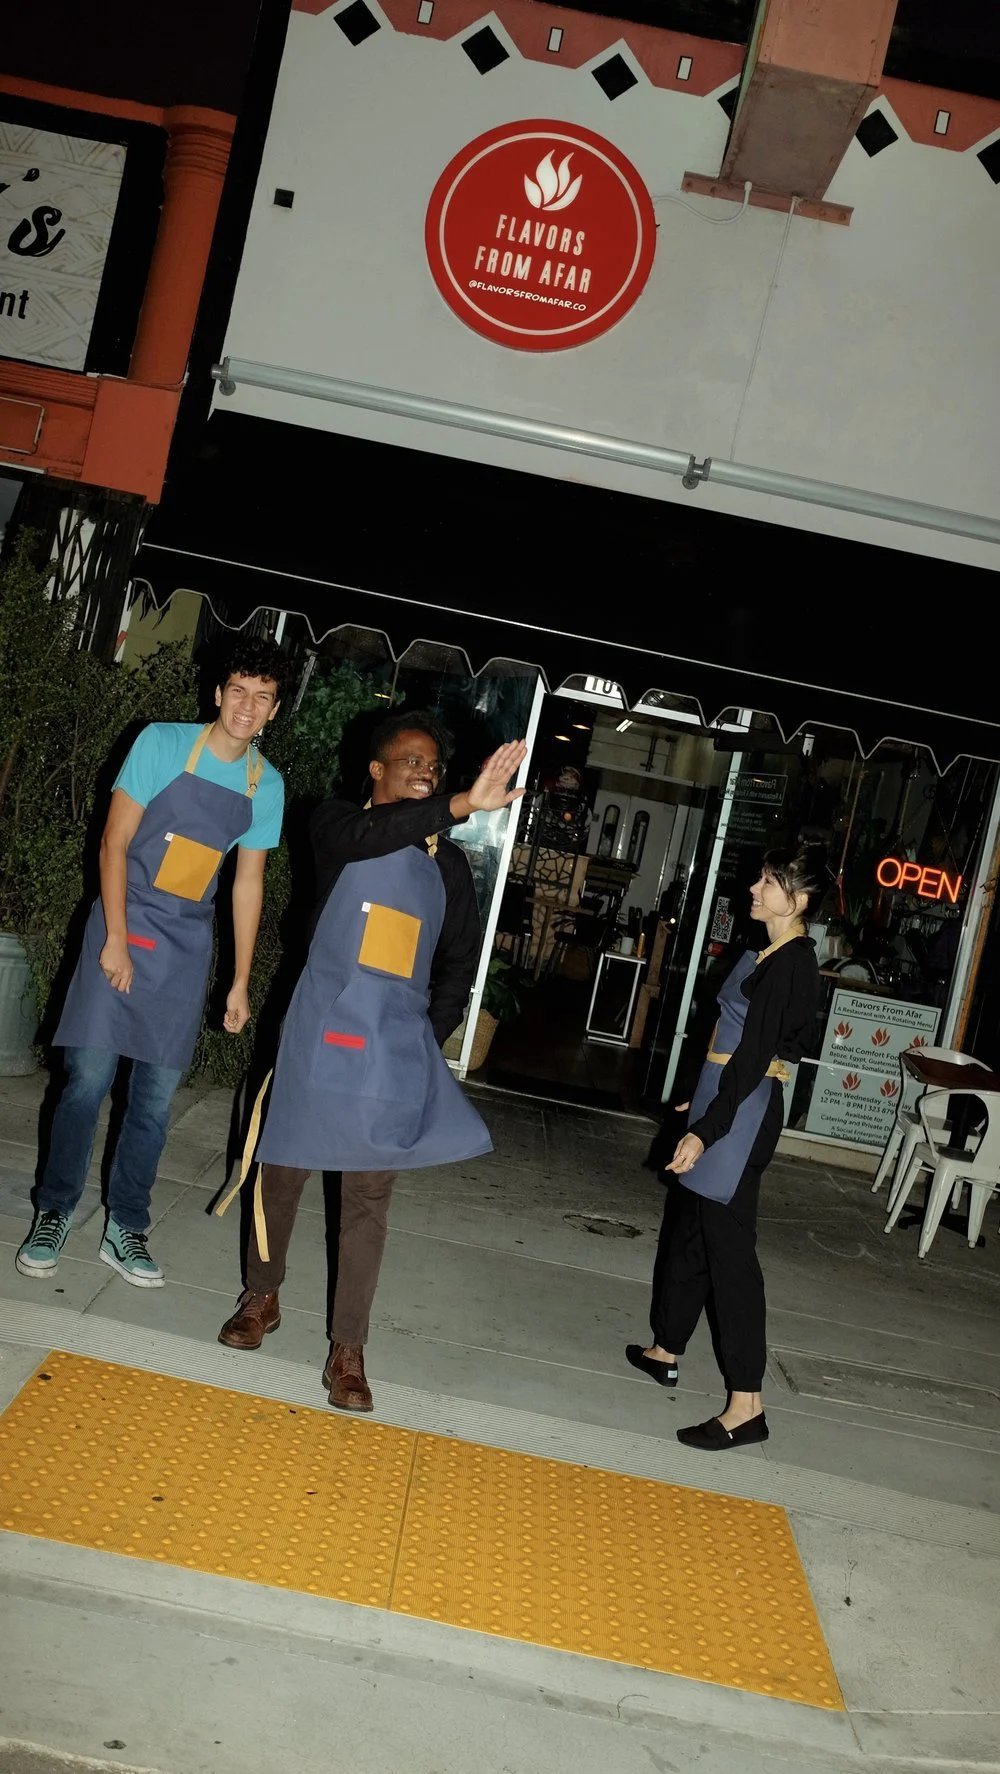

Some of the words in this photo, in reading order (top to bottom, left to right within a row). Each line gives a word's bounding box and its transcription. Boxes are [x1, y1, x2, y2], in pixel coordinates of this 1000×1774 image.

[496, 214, 586, 256] FLAVORS
[474, 245, 532, 281] FROM
[539, 260, 592, 294] AFAR
[468, 280, 587, 312] @FLAVORSFROMAFAR.CO
[877, 858, 963, 903] OPEN
[843, 1007, 873, 1017] Restaurant
[892, 1016, 916, 1026] Rotating
[917, 1021, 933, 1029] Menu
[851, 999, 880, 1011] Flavors
[883, 1006, 903, 1016] From
[905, 1009, 922, 1019] Afar
[831, 1043, 854, 1053] Global
[855, 1047, 885, 1059] Comfort
[886, 1053, 901, 1061] Foo
[861, 1064, 884, 1074] Somalia
[885, 1068, 896, 1076] and
[824, 1088, 842, 1099] Open
[844, 1092, 881, 1105] Wednesday
[830, 1098, 840, 1106] PM
[868, 1105, 880, 1113] 323
[881, 1107, 894, 1116] 879
[820, 1114, 847, 1125] Catering
[861, 1121, 883, 1131] Private
[845, 1111, 873, 1121] Available
[874, 1115, 883, 1123] for
[836, 1126, 853, 1134] Social
